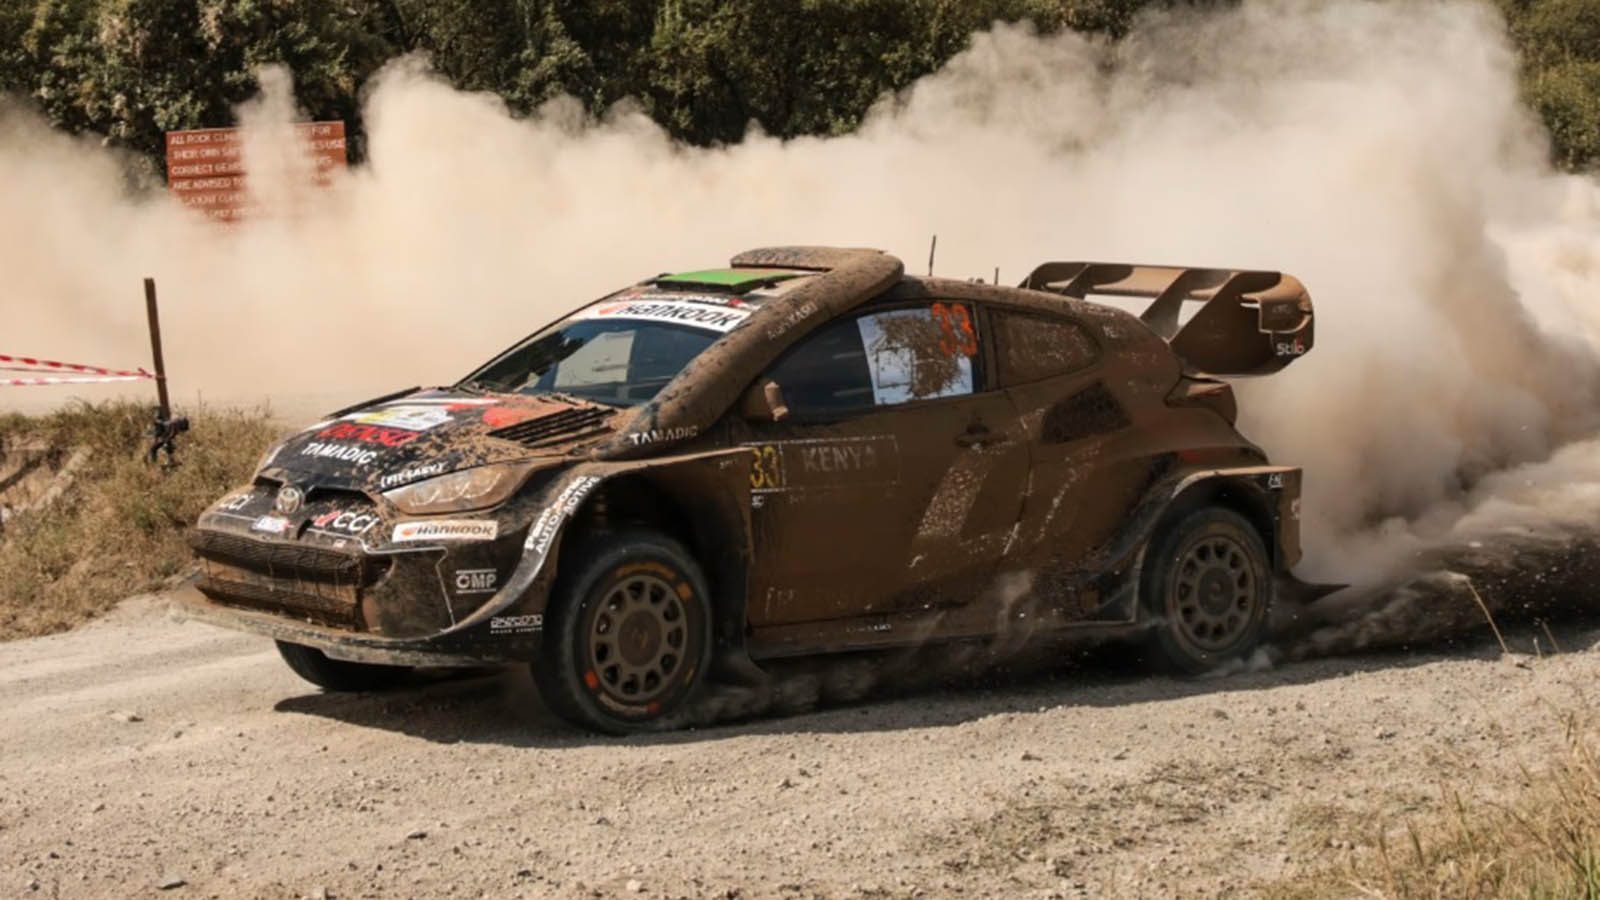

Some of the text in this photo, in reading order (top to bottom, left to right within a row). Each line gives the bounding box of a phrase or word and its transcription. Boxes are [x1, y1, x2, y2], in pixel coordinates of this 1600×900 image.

[170, 135, 185, 145] ALL
[932, 303, 977, 356] 33
[630, 426, 698, 445] TAMADIC
[302, 442, 377, 464] TAMADIC
[803, 446, 876, 473] KENYA
[751, 446, 781, 488] 33
[333, 512, 380, 533] CCI
[456, 574, 497, 588] OMP
